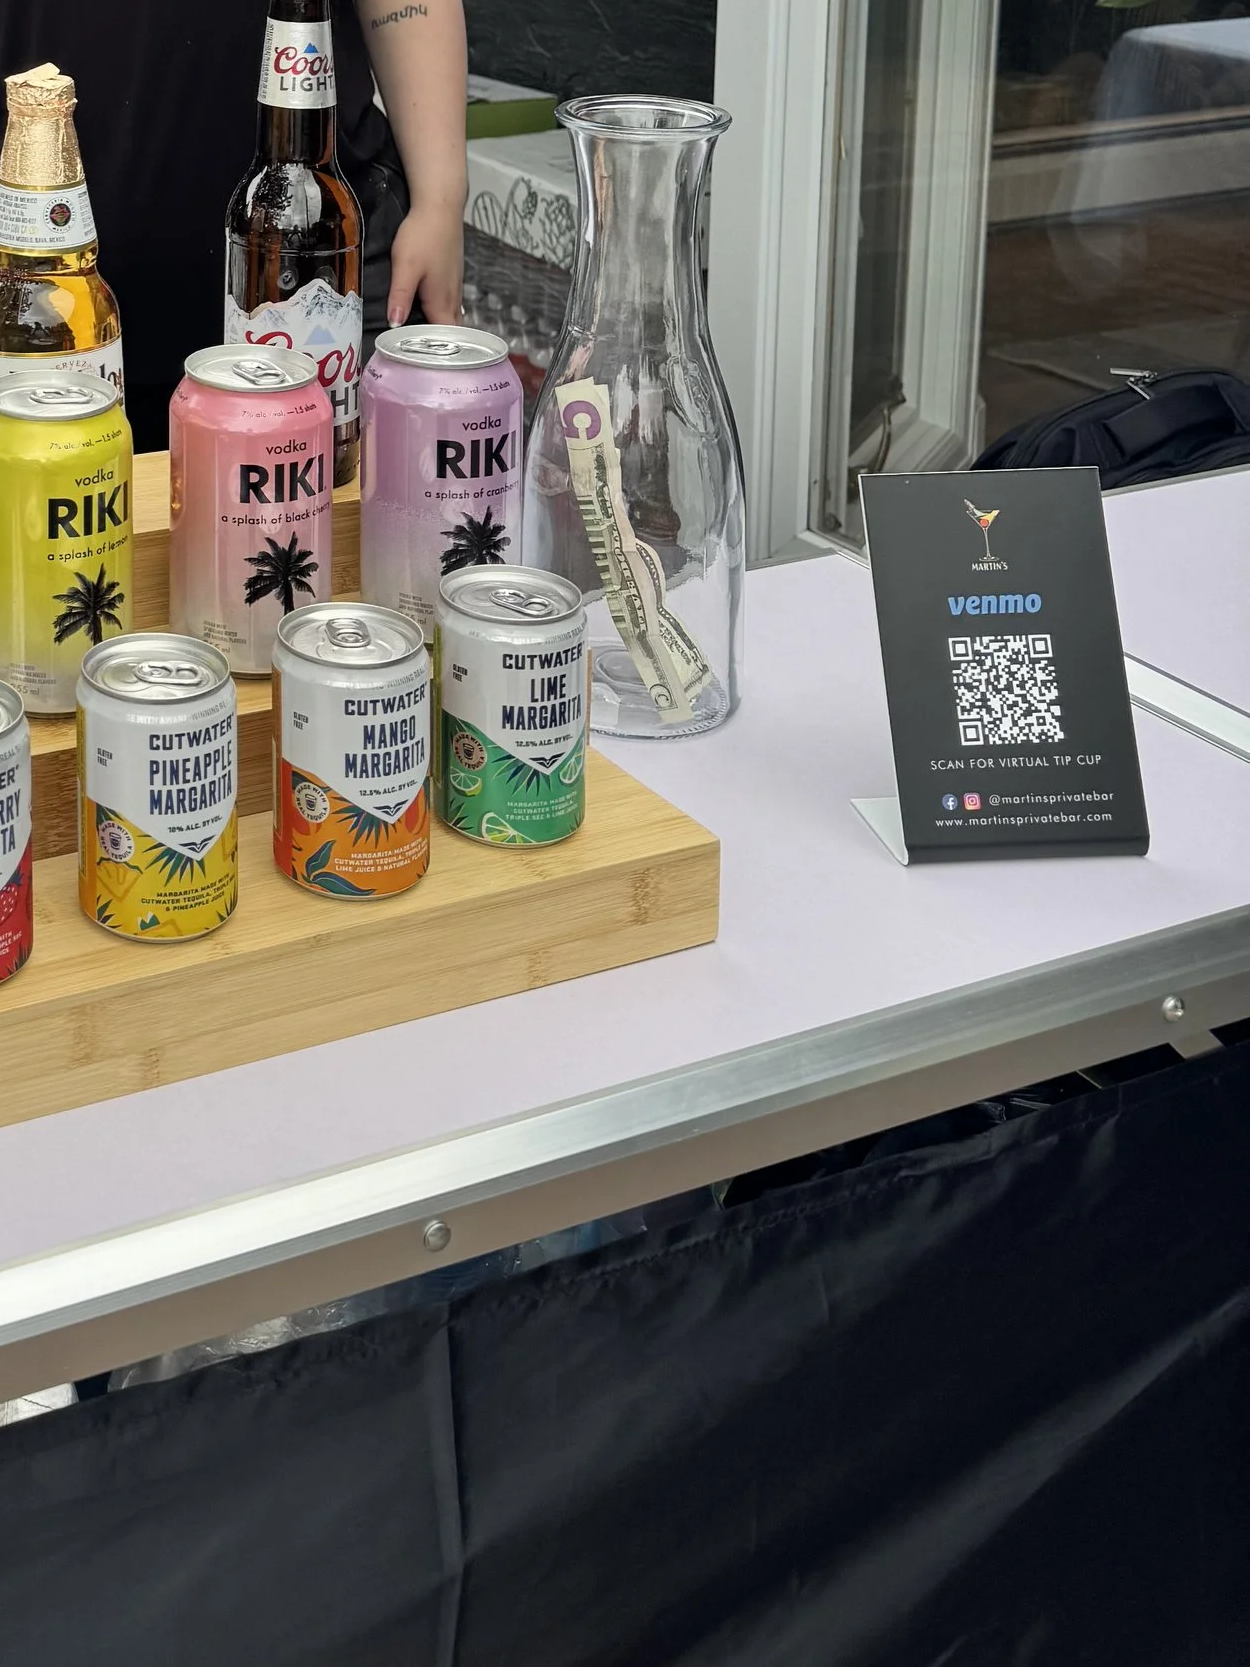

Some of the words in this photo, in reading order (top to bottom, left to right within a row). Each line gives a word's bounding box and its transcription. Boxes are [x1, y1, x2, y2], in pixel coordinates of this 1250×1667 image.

[279, 76, 335, 92] LIGHT
[462, 415, 502, 432] vodka
[265, 439, 307, 456] vodka
[436, 430, 517, 480] RIKI
[75, 468, 114, 488] vodka
[239, 453, 325, 505] RIKI
[425, 491, 432, 499] a
[435, 488, 470, 501] splash
[473, 486, 484, 498] of
[48, 479, 129, 540] RIKI
[221, 515, 228, 523] a
[232, 513, 267, 527] splash
[270, 513, 283, 525] of
[285, 508, 311, 523] black
[47, 553, 55, 561] a
[59, 546, 93, 563] splash
[96, 542, 106, 555] of
[972, 561, 1008, 572] MARTIN'S
[948, 593, 1042, 616] venmo
[502, 643, 583, 670] CUTWATER
[344, 684, 426, 716] CUTWATER
[530, 674, 567, 703] LIME
[502, 694, 582, 730] MARGARITA
[149, 717, 232, 751] CUTWATER
[363, 715, 417, 751] MANGO
[150, 739, 232, 786] PINEAPPLE
[344, 737, 425, 779] MARGARITA
[930, 760, 964, 771] SCAN
[970, 758, 995, 769] FOR
[999, 757, 1050, 768] VIRTUAL
[1054, 755, 1072, 766] TIP
[1077, 754, 1102, 765] CUP
[149, 770, 232, 816] MARGARITA
[988, 791, 1114, 807] @martinsprivatebar
[935, 812, 1113, 828] www.martinsprivatebar.com
